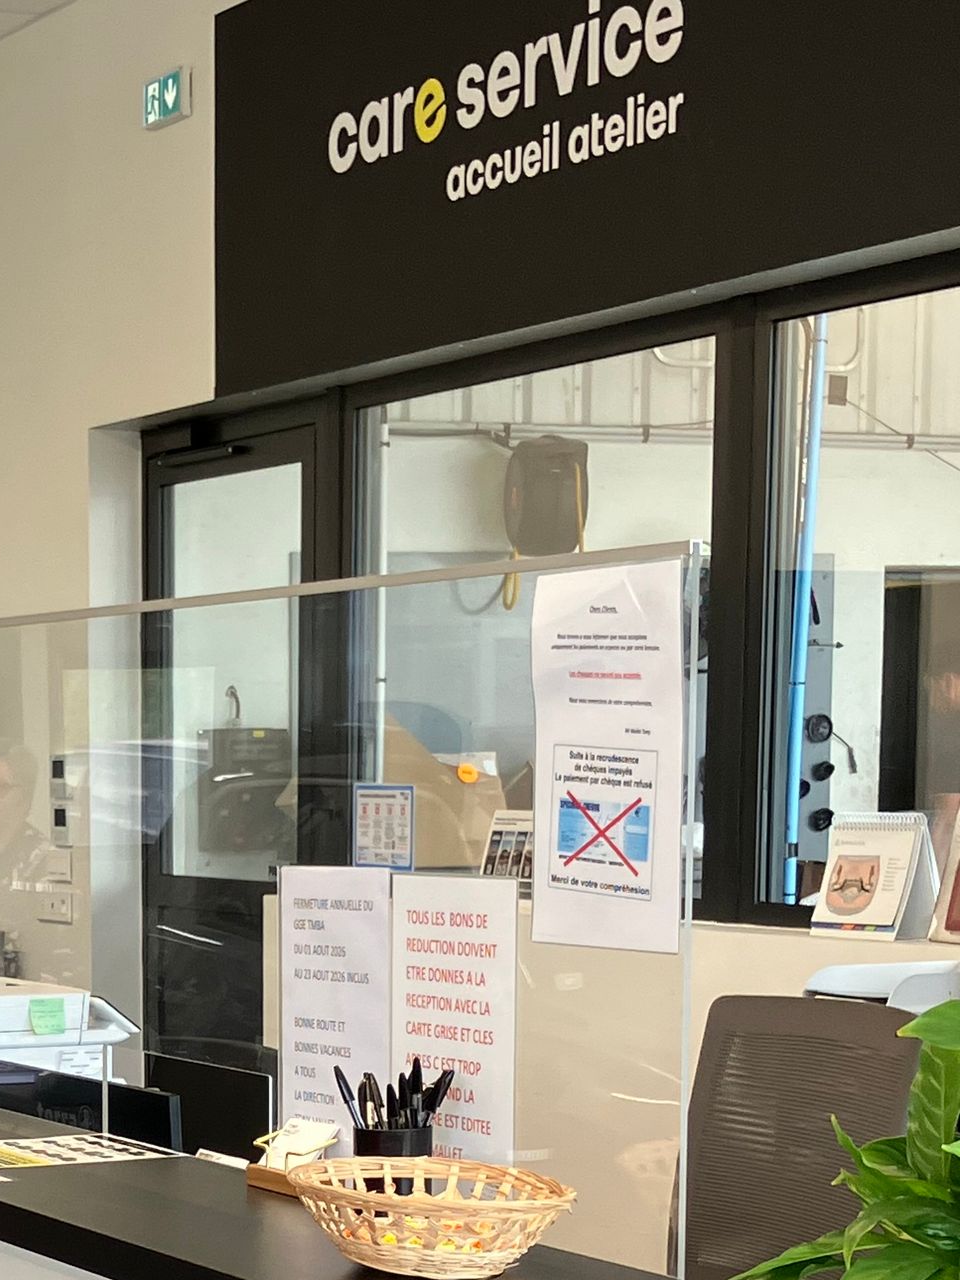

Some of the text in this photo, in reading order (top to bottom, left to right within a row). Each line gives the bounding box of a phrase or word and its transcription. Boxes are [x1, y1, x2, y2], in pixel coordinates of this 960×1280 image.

[328, 0, 685, 174] care service
[446, 93, 685, 202] accueil atelier
[569, 750, 584, 760] Suite
[563, 774, 589, 783] paiement
[590, 776, 599, 785] par
[551, 874, 569, 885] Merci
[570, 876, 579, 886] de
[581, 879, 598, 889] votre
[293, 897, 328, 910] FERMETURE
[330, 899, 362, 911] ANNUELLE
[406, 909, 488, 929] TOUS LES BONS DE
[312, 945, 330, 956] AOUT
[406, 937, 497, 959] REDUCTION DOIVENT
[312, 969, 330, 981] AOUT
[406, 965, 486, 987] ETRE DONNES A LA
[405, 992, 491, 1017] RECEPTION AVEC LA
[294, 1016, 345, 1033] BONNE ROUTE ET
[405, 1020, 494, 1046] CARTE GRISE ET CLES
[294, 1041, 352, 1059] BONNES VACANCES
[294, 1066, 316, 1079] A TOUS
[405, 1052, 482, 1076] APES C EST TROP
[294, 1089, 335, 1105] LA DIRECTION
[463, 1089, 475, 1104] LA
[444, 1113, 460, 1129] EST
[461, 1116, 492, 1136] EDITEE
